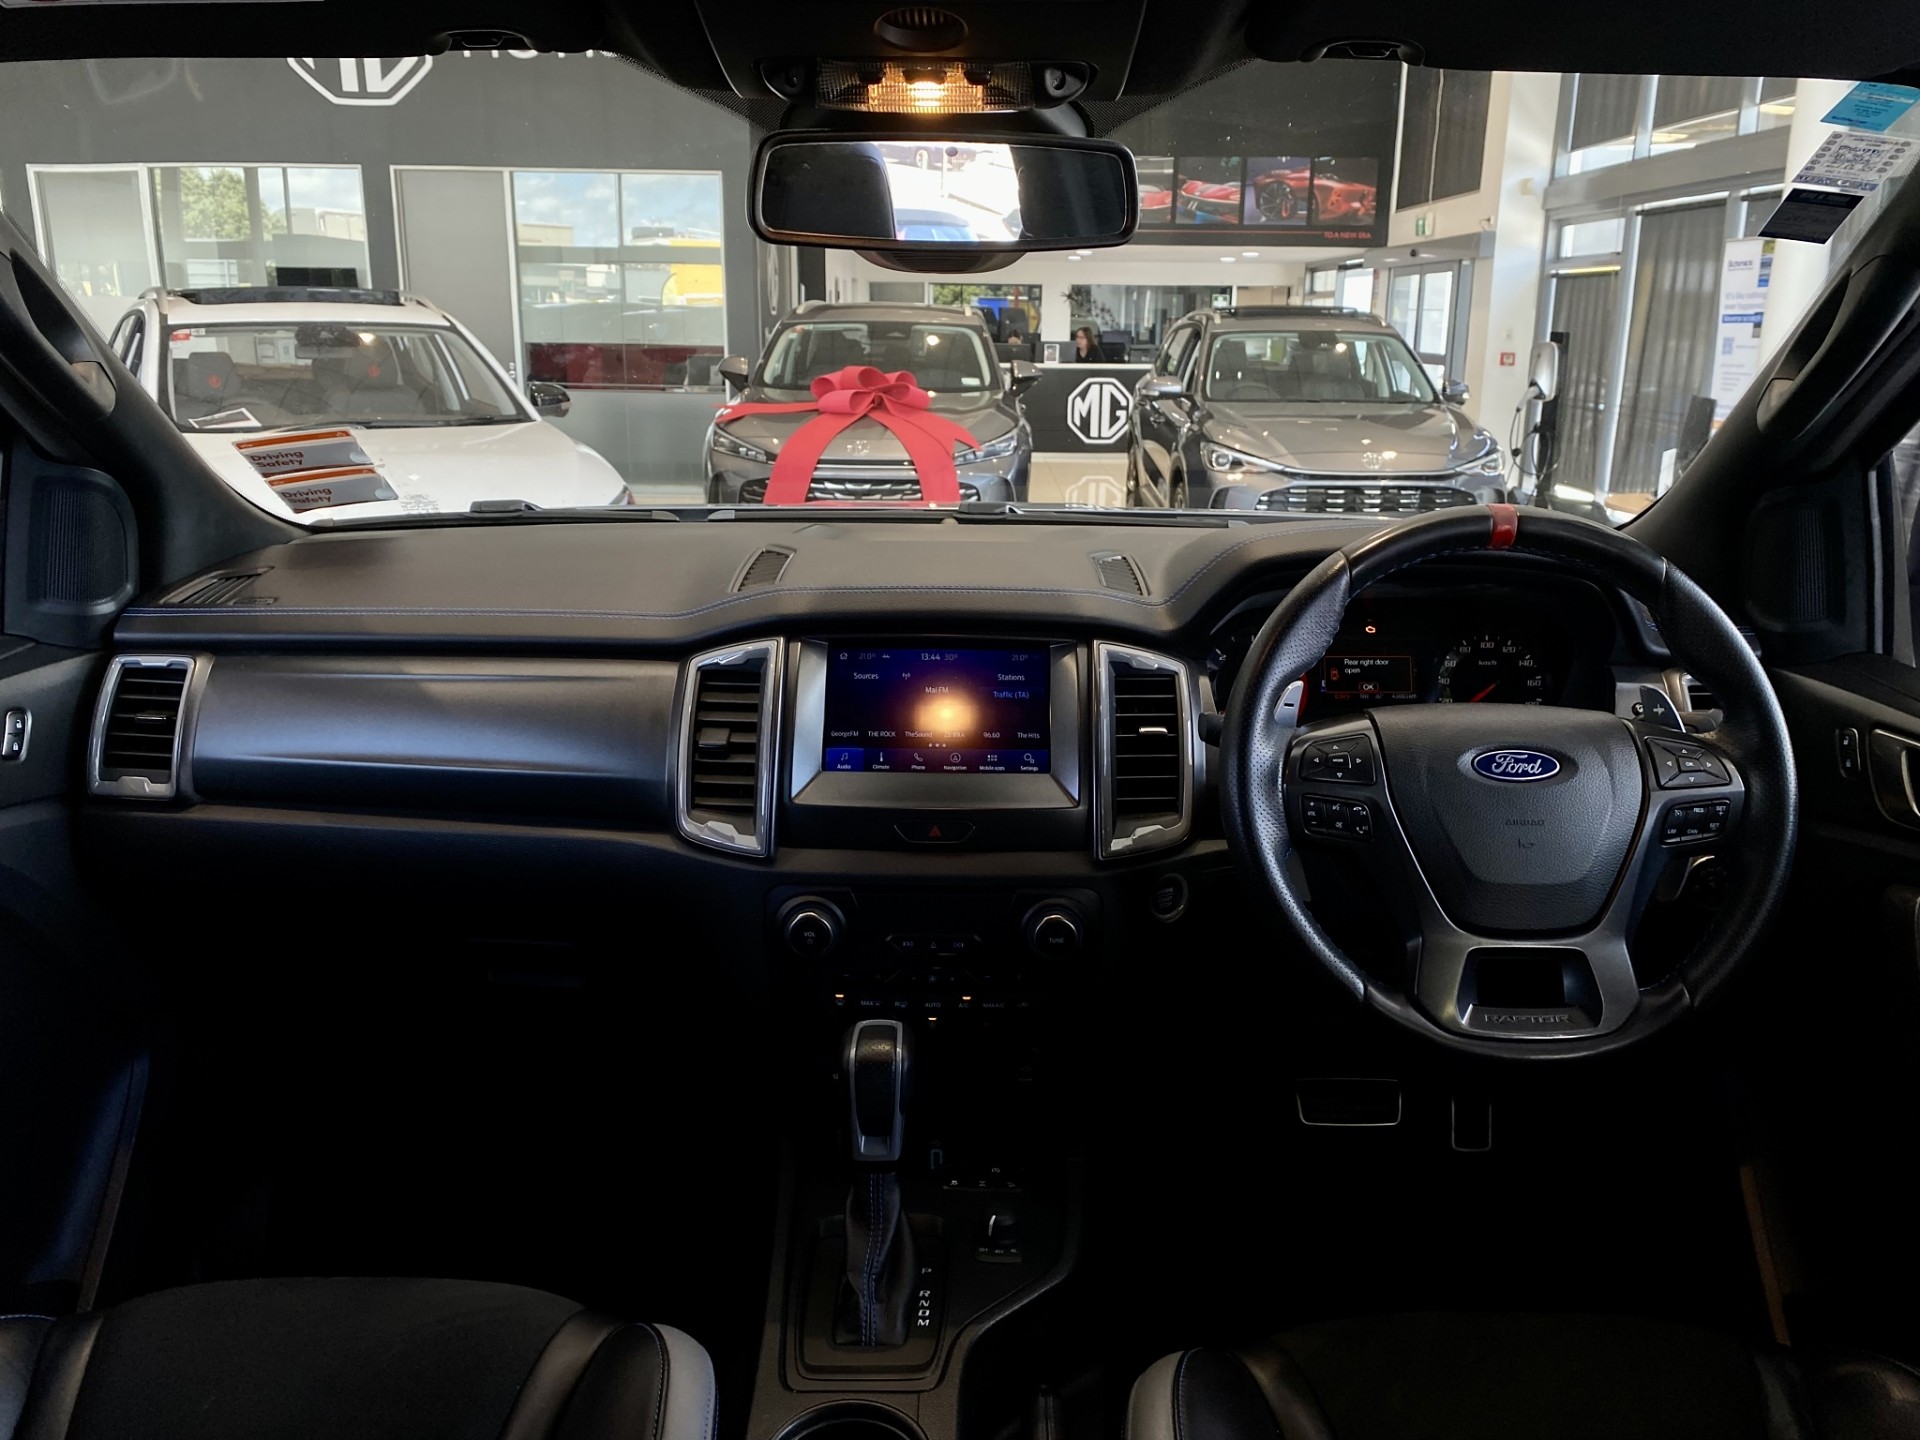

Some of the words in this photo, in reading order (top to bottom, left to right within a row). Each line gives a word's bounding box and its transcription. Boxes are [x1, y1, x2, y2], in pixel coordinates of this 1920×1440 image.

[1073, 383, 1128, 438] MG
[250, 450, 304, 462] Driving
[256, 458, 304, 468] Safety
[281, 487, 332, 499] Driving
[288, 495, 332, 504] Safety
[1480, 641, 1495, 649] 100
[921, 652, 941, 661] 13:44
[1344, 658, 1359, 666] Rear
[1360, 658, 1374, 668] right
[1375, 658, 1389, 666] door
[1444, 660, 1456, 668] 60
[1344, 667, 1360, 675] open
[853, 672, 879, 680] Sources
[997, 673, 1025, 681] Stations
[1362, 683, 1375, 691] OK
[1527, 679, 1541, 687] 160
[938, 686, 949, 694] FM
[993, 690, 1013, 699] Traffic
[1014, 690, 1030, 700] (TA)
[868, 730, 879, 738] THE
[880, 730, 897, 738] ROCK
[943, 764, 968, 772] Navigation
[1490, 753, 1543, 774] Ford
[1019, 765, 1040, 773] Settings
[803, 930, 816, 938] VOL
[1484, 1013, 1575, 1024] RAPTOR
[921, 1267, 932, 1275] P
[918, 1289, 931, 1298] R
[917, 1299, 930, 1308] N
[917, 1308, 930, 1317] D
[916, 1318, 930, 1327] M
